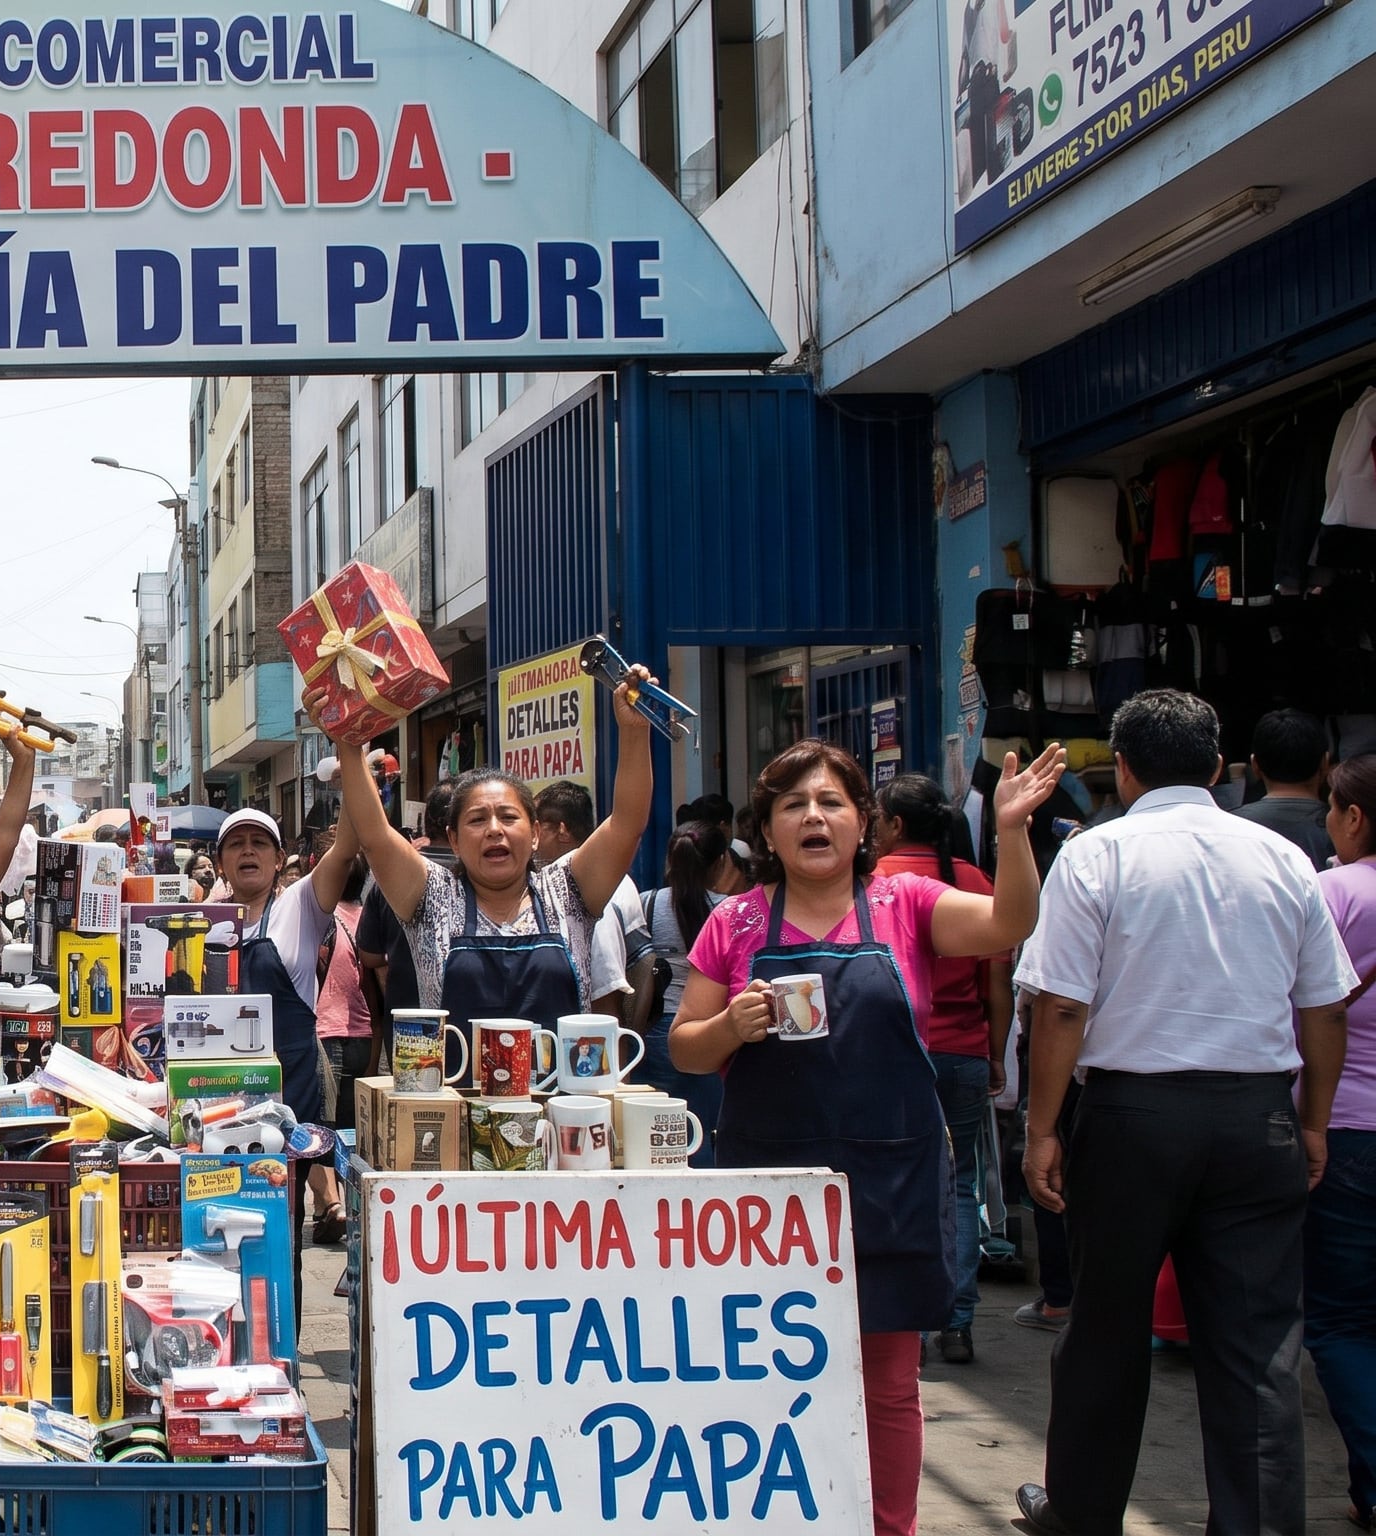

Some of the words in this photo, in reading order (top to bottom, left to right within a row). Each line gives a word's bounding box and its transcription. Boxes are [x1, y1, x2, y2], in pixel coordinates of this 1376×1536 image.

[1073, 9, 1146, 107] 7523
[1194, 15, 1251, 81] PERU
[115, 246, 297, 346] DEL
[326, 240, 664, 343] PADRE
[505, 745, 540, 780] PARA
[544, 728, 584, 778] PAPÁ
[507, 690, 579, 741] DETALLES
[378, 1182, 636, 1285] ¡ÚLTIMA
[654, 1183, 844, 1284] HORA!
[403, 1290, 830, 1392] DETALLES
[398, 1437, 563, 1522] PARA
[579, 1391, 820, 1523] PAPÁ
